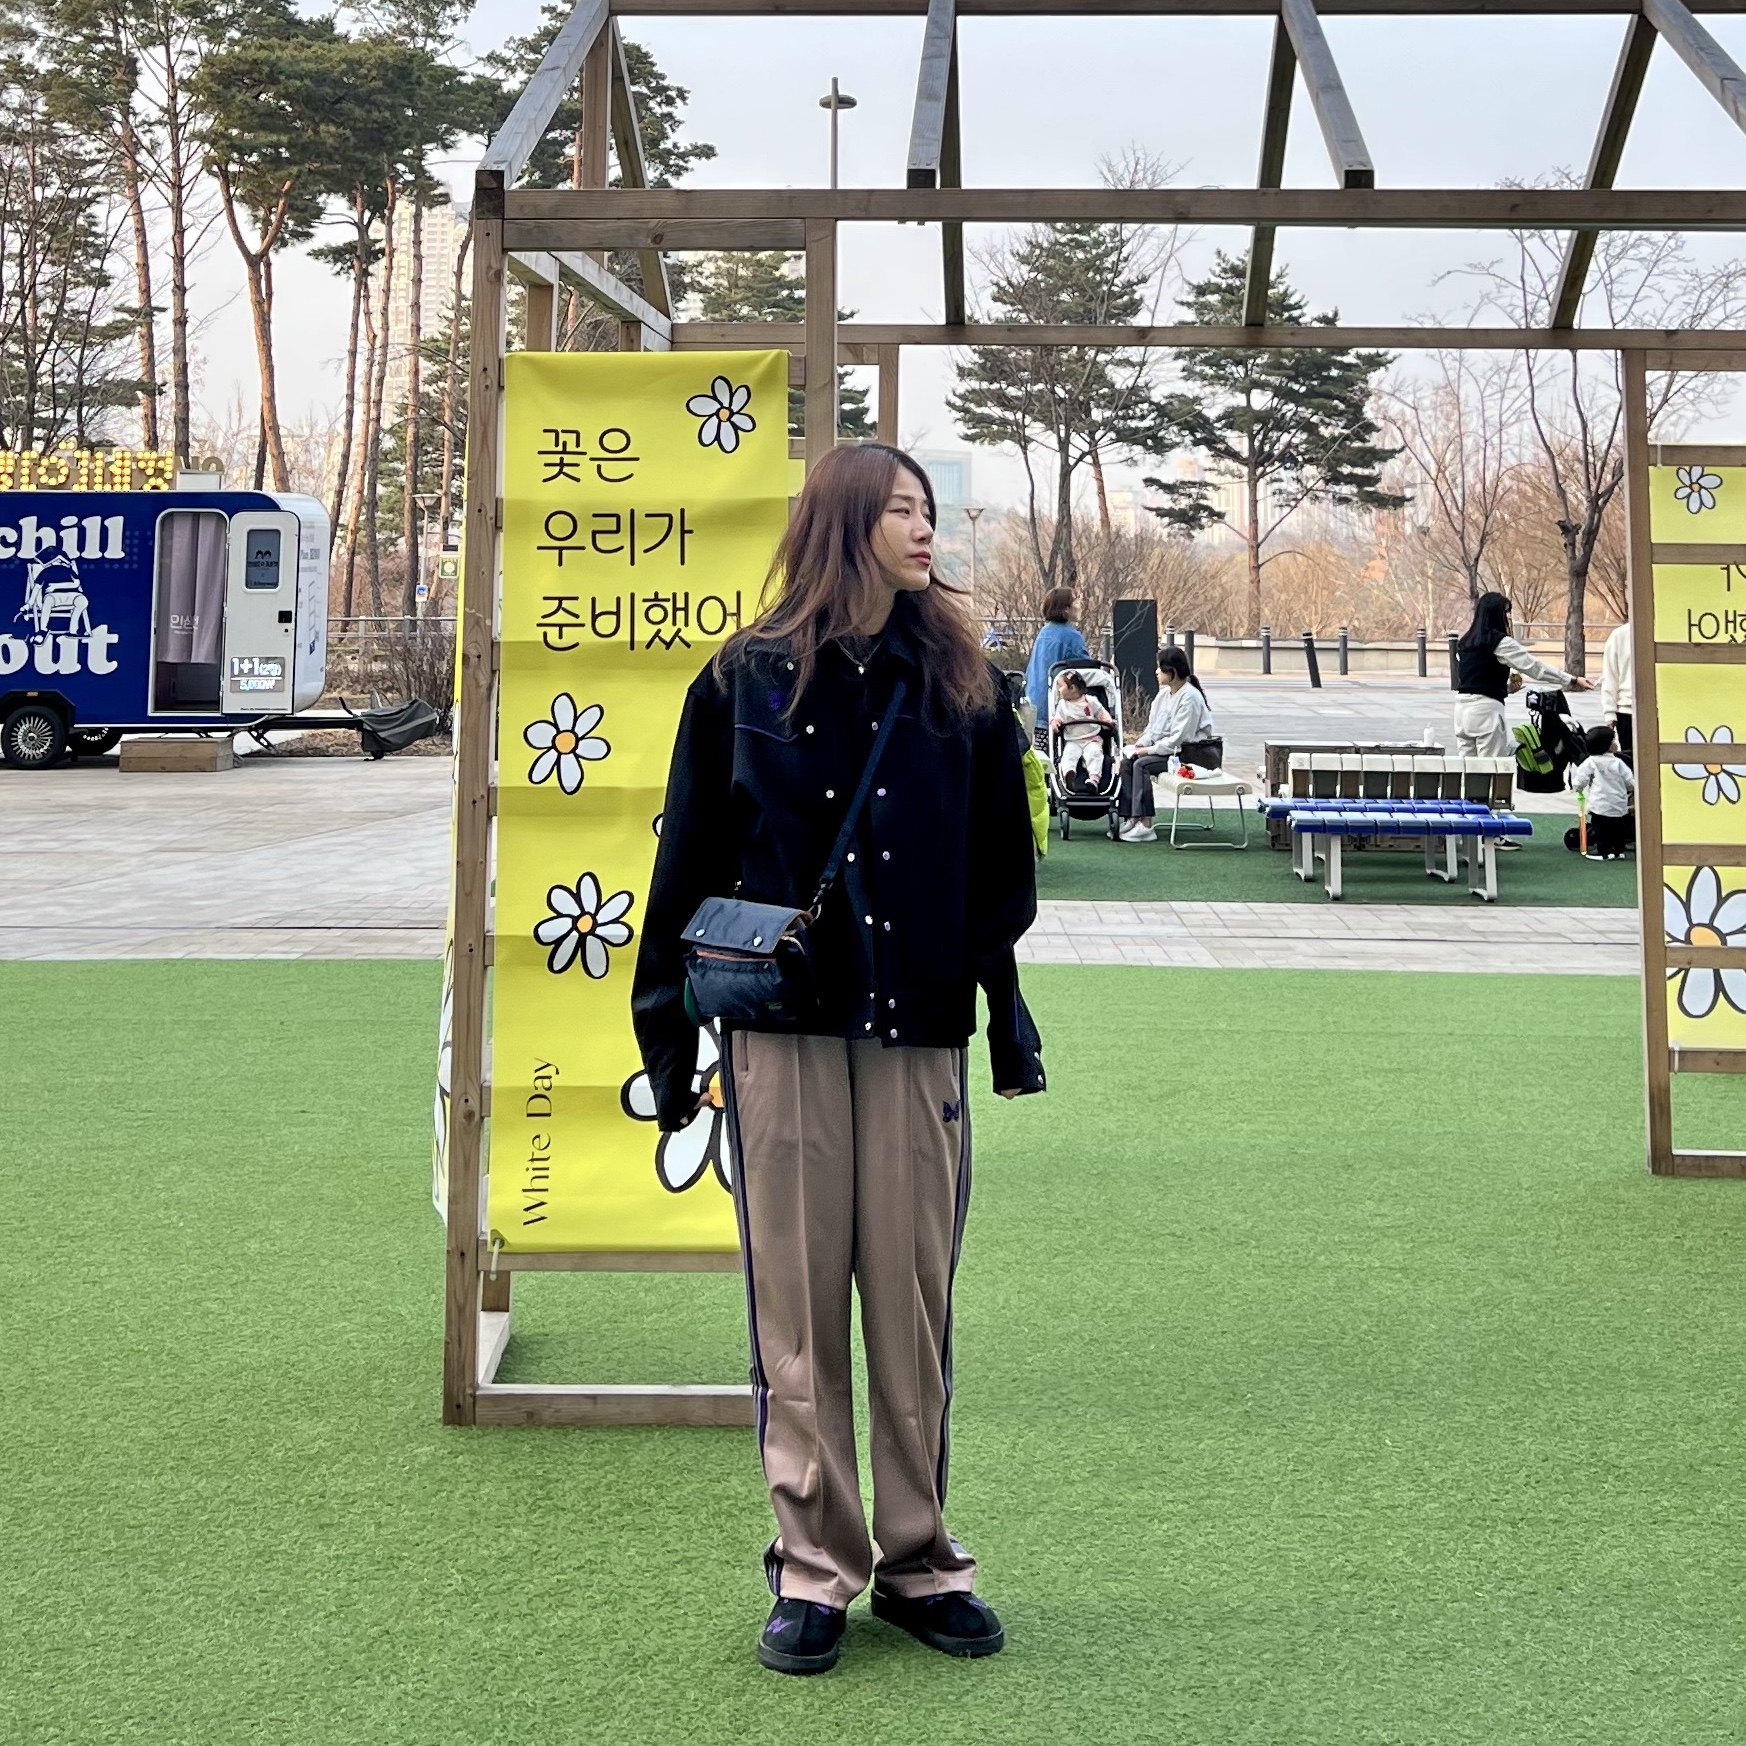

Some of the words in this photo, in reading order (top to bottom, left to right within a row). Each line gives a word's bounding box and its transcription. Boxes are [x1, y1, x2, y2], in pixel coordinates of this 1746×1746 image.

[537, 427, 640, 483] 꽃은
[536, 507, 694, 567] 우리가
[0, 624, 119, 675] out
[536, 590, 742, 651] 준비했어
[525, 1057, 560, 1118] Day
[522, 1132, 552, 1226] White
